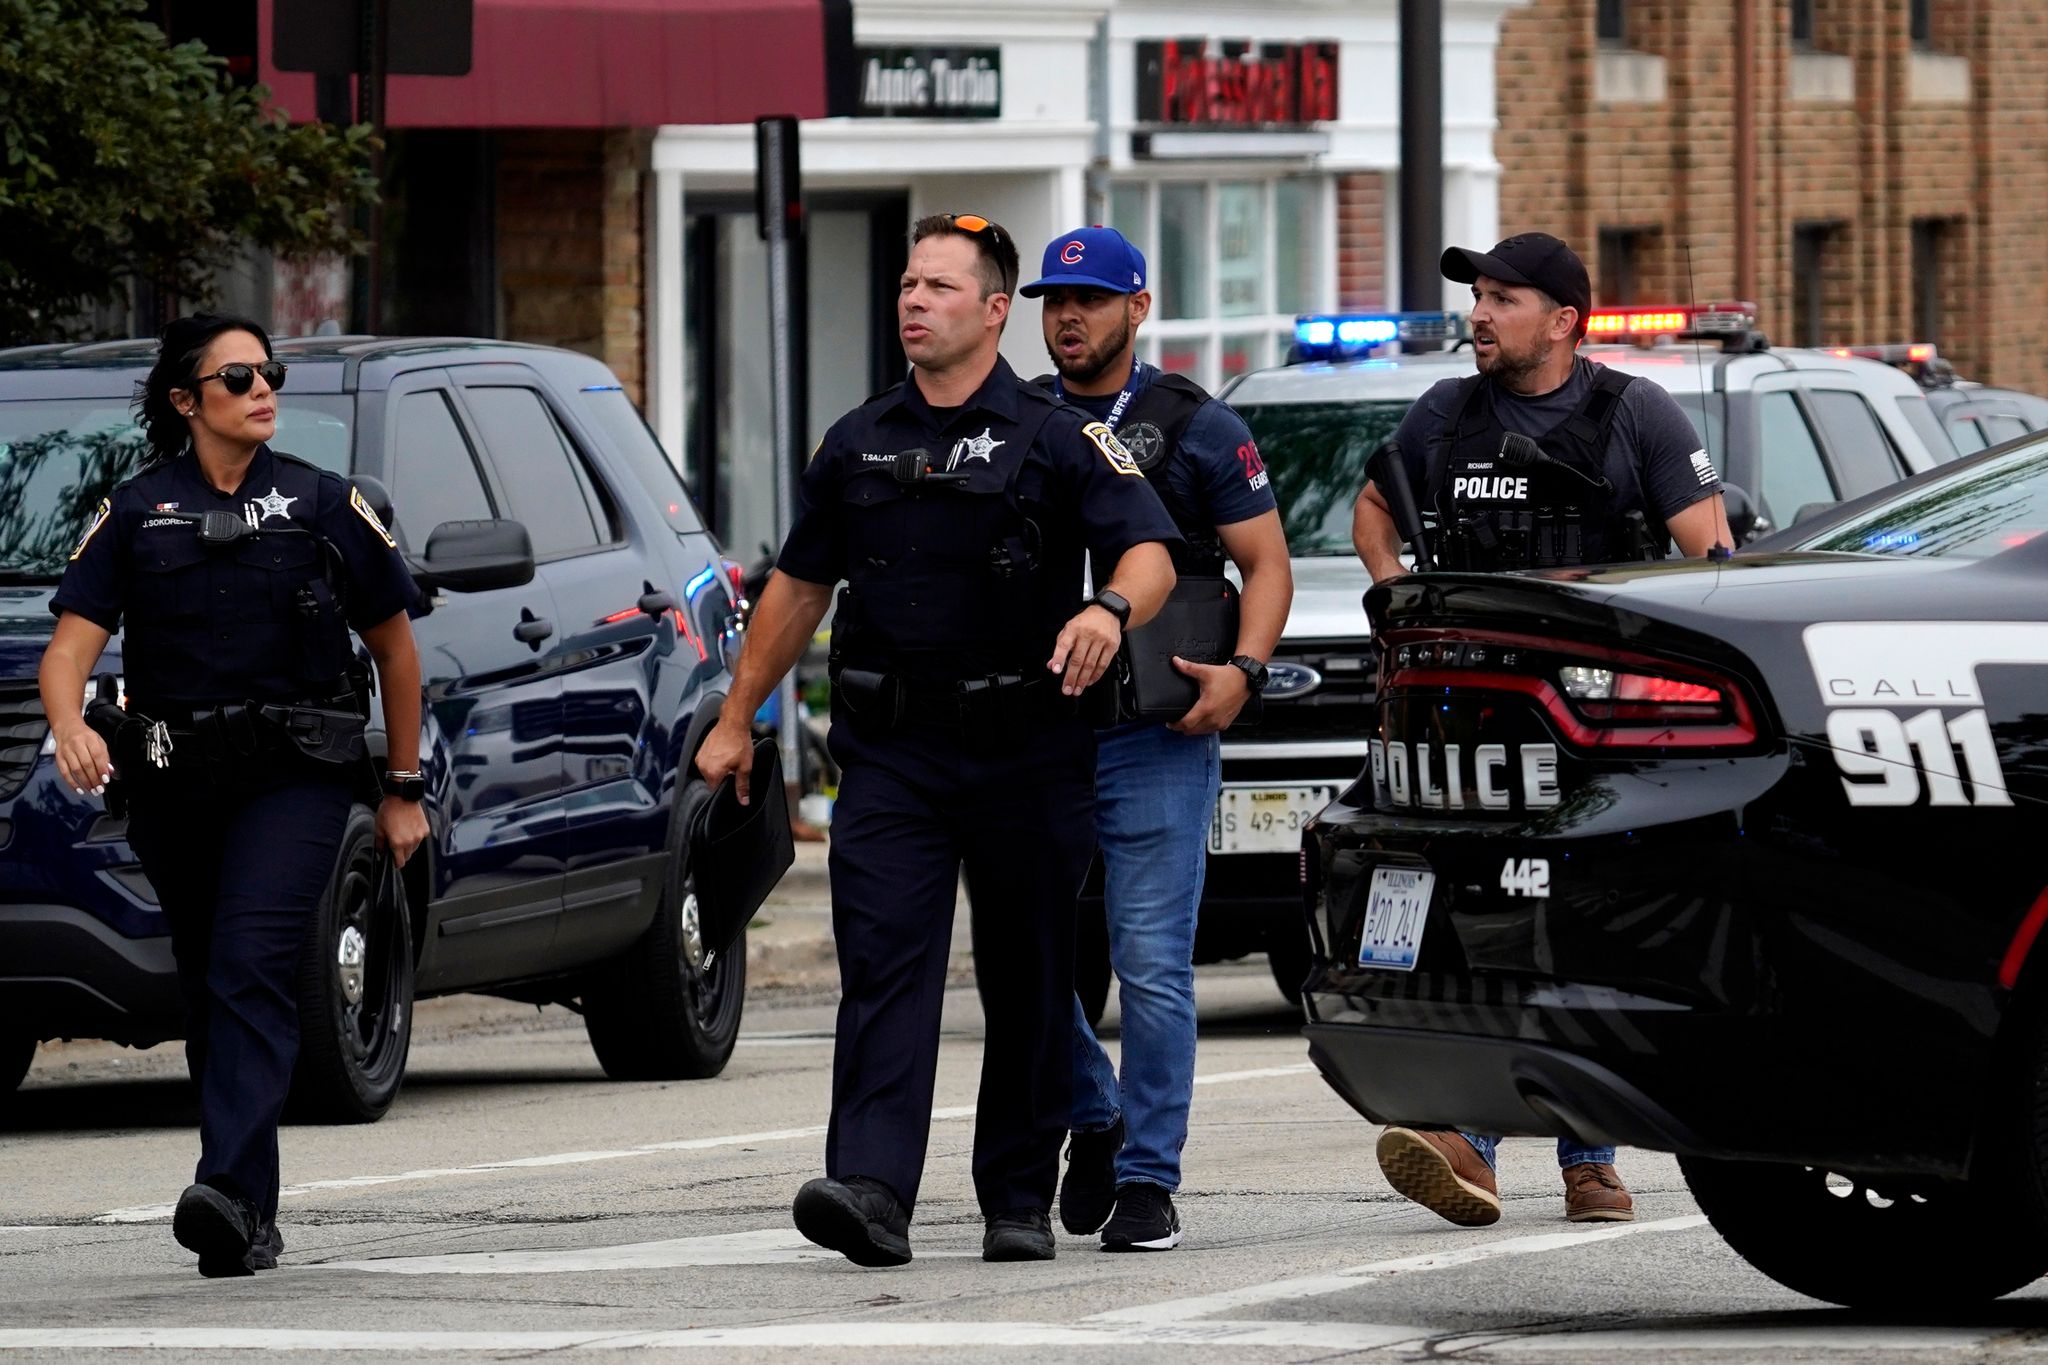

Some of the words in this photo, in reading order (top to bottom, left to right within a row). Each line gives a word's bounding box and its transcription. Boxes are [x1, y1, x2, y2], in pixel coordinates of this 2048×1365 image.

[863, 56, 928, 107] Annie
[1060, 240, 1085, 264] C
[1112, 390, 1132, 416] OFFICE
[1453, 476, 1529, 499] POLICE
[1399, 648, 1517, 667] DODGE
[1829, 679, 1971, 697] CALL
[1826, 709, 2016, 806] 911
[1370, 738, 1561, 810] POLICE
[1251, 792, 1288, 801] ILLINOIS
[1224, 811, 1237, 833] S
[1387, 871, 1417, 888] ILLINOIS
[1500, 857, 1551, 897] 442
